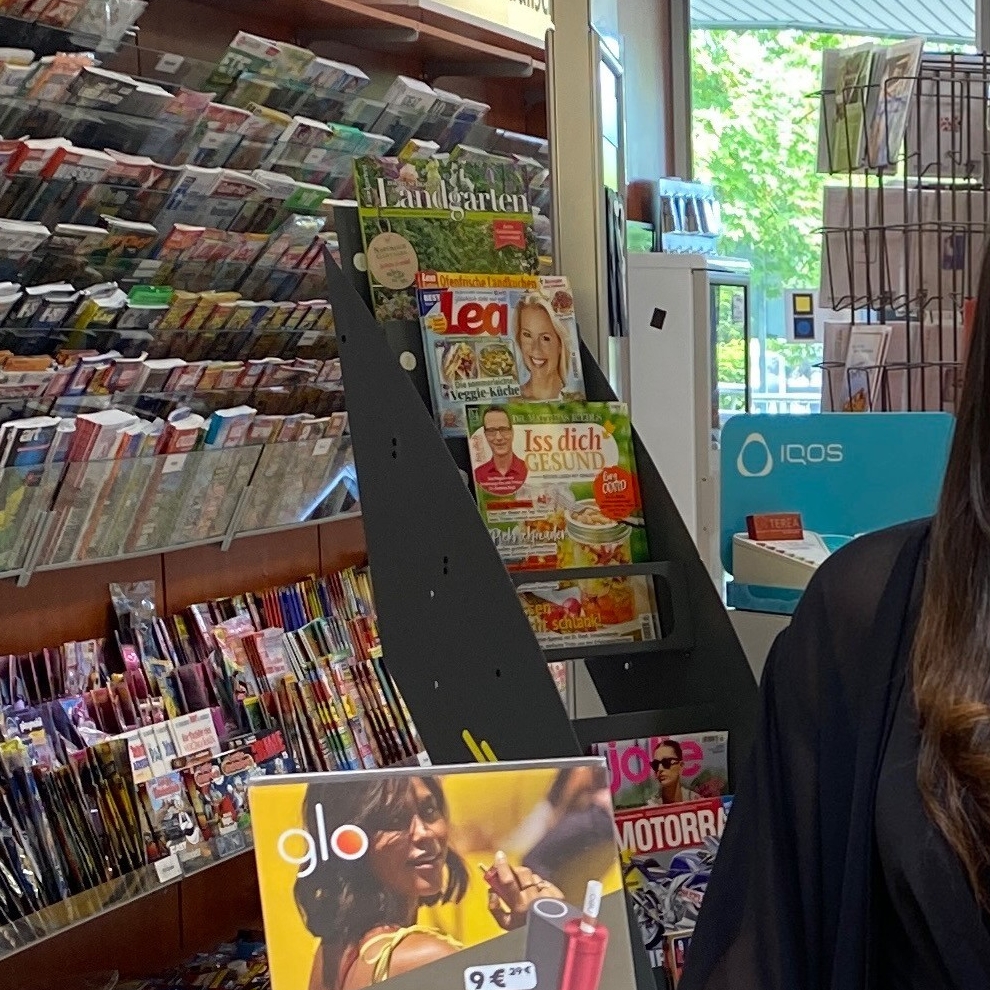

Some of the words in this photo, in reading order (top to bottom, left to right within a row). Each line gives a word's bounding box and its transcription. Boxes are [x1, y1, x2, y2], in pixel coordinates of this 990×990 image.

[378, 177, 528, 222] Landgarten
[440, 291, 508, 336] Lea
[524, 428, 556, 452] Iss
[558, 426, 602, 450] dich
[780, 443, 844, 465] IQOS
[525, 452, 606, 472] GESUND
[608, 735, 704, 796] jole
[276, 802, 368, 878] glo
[614, 806, 726, 853] MOTORRA
